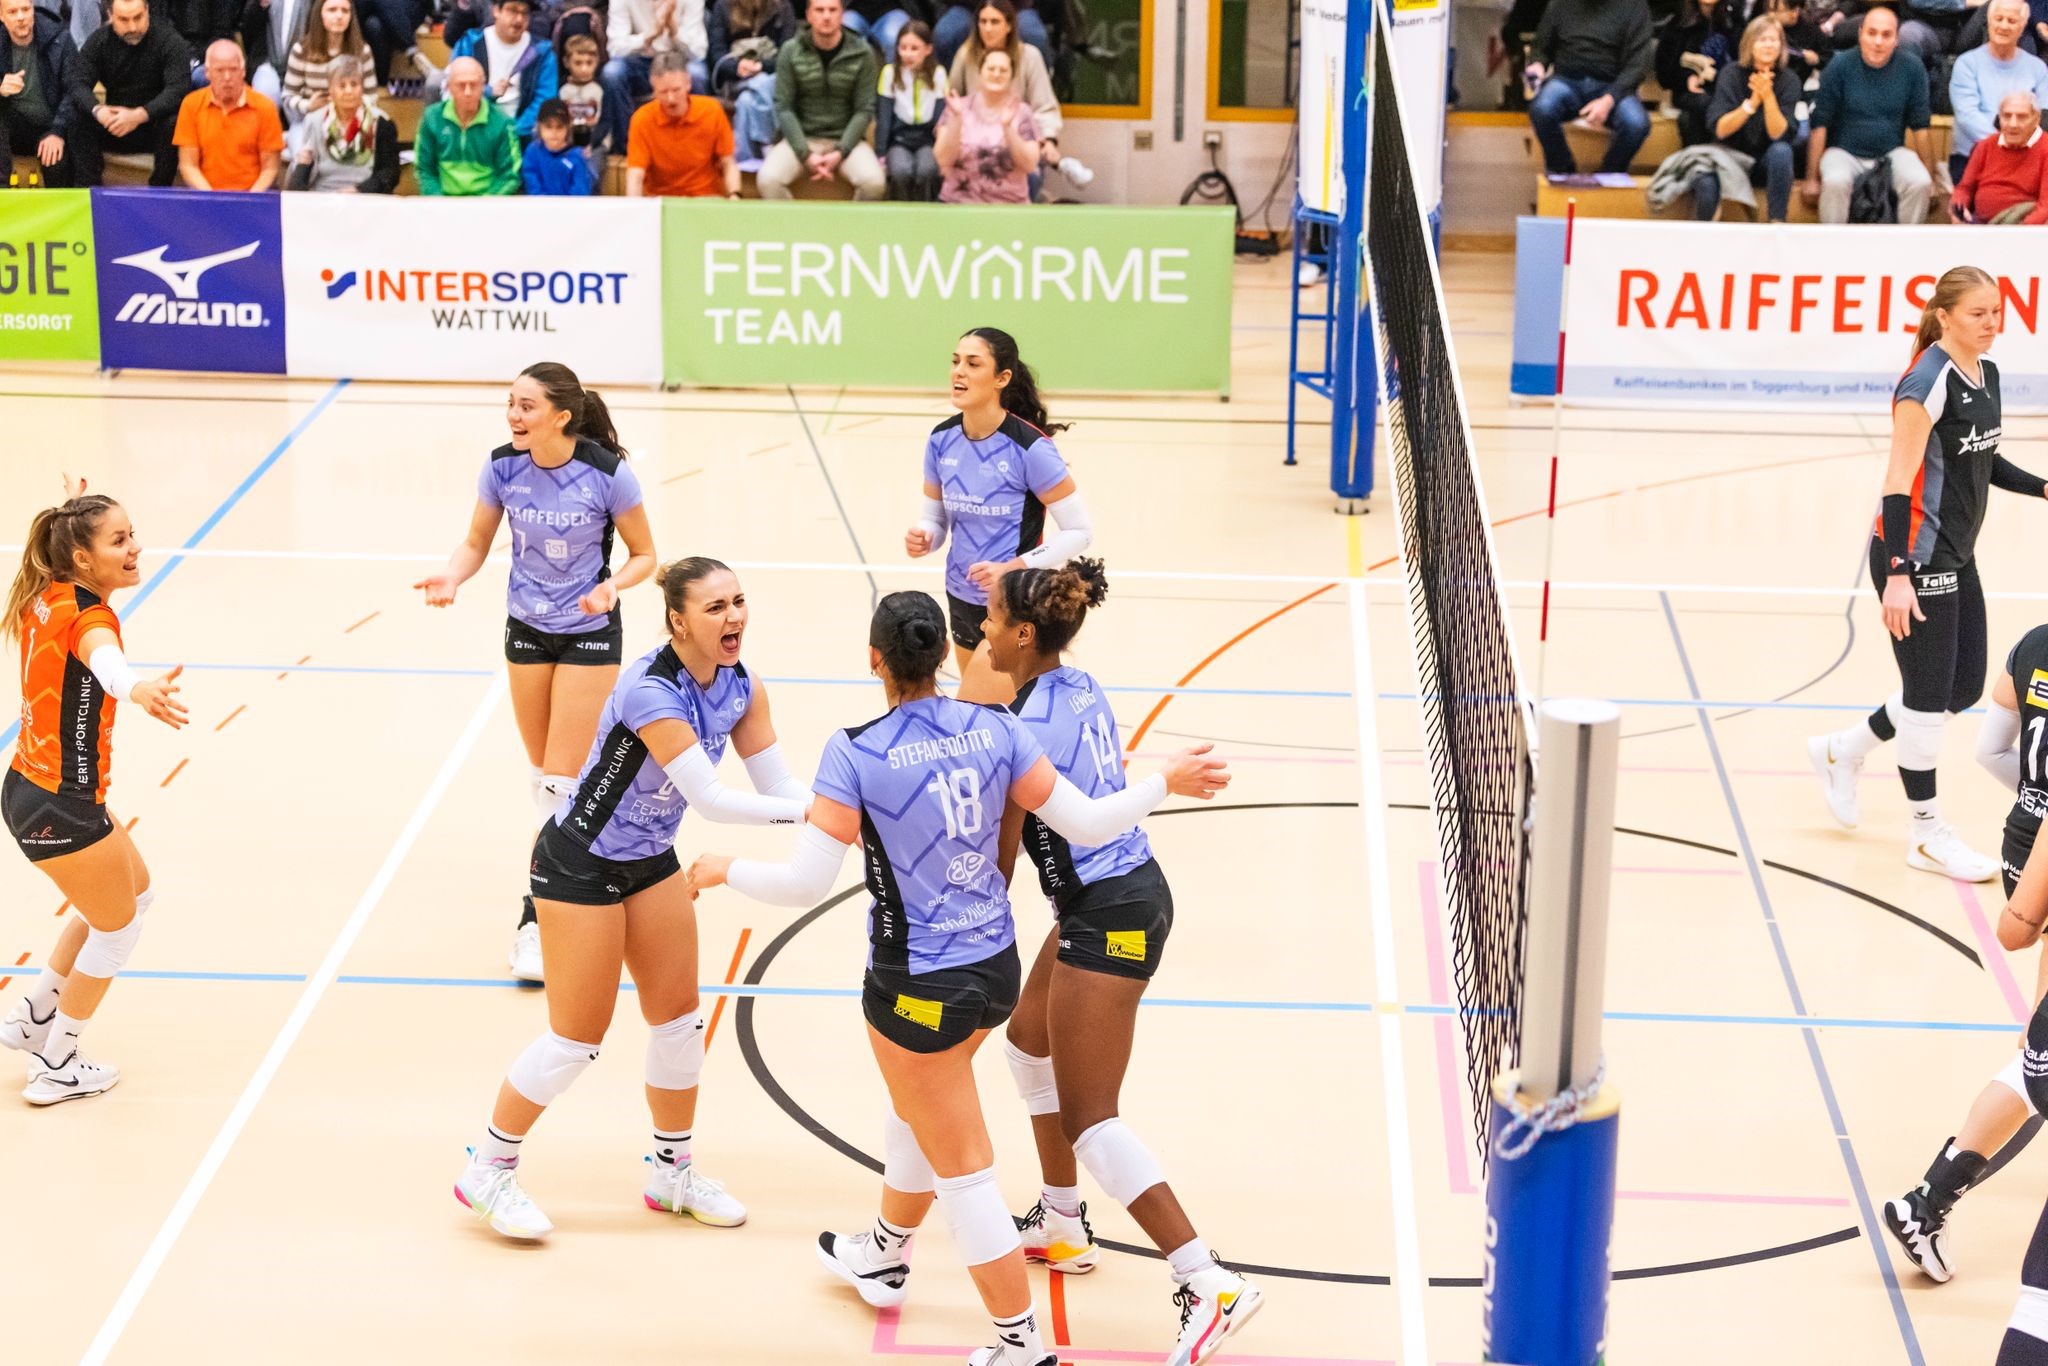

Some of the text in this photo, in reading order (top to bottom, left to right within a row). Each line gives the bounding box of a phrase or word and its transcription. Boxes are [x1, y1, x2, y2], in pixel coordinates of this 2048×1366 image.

[365, 268, 628, 303] INTERSPORT
[703, 238, 1189, 303] FERNWÄRME
[432, 308, 557, 332] WATTWIL
[1616, 269, 2039, 335] RAIFFEISN
[0, 313, 73, 330] RSORGT
[704, 308, 842, 345] TEAM
[1730, 382, 1747, 392] im
[1752, 379, 1831, 396] Toggenburg
[1834, 383, 1860, 394] und
[1863, 382, 1893, 394] Neck
[584, 641, 610, 651] nine
[1068, 686, 1097, 715] LEWIS
[887, 728, 996, 770] STEFÁNSDÓTTIR
[1081, 711, 1118, 785] 14
[2028, 715, 2048, 782] 1
[593, 737, 634, 802] PORTCLINIC
[927, 767, 983, 840] 18
[1058, 938, 1071, 949] ne
